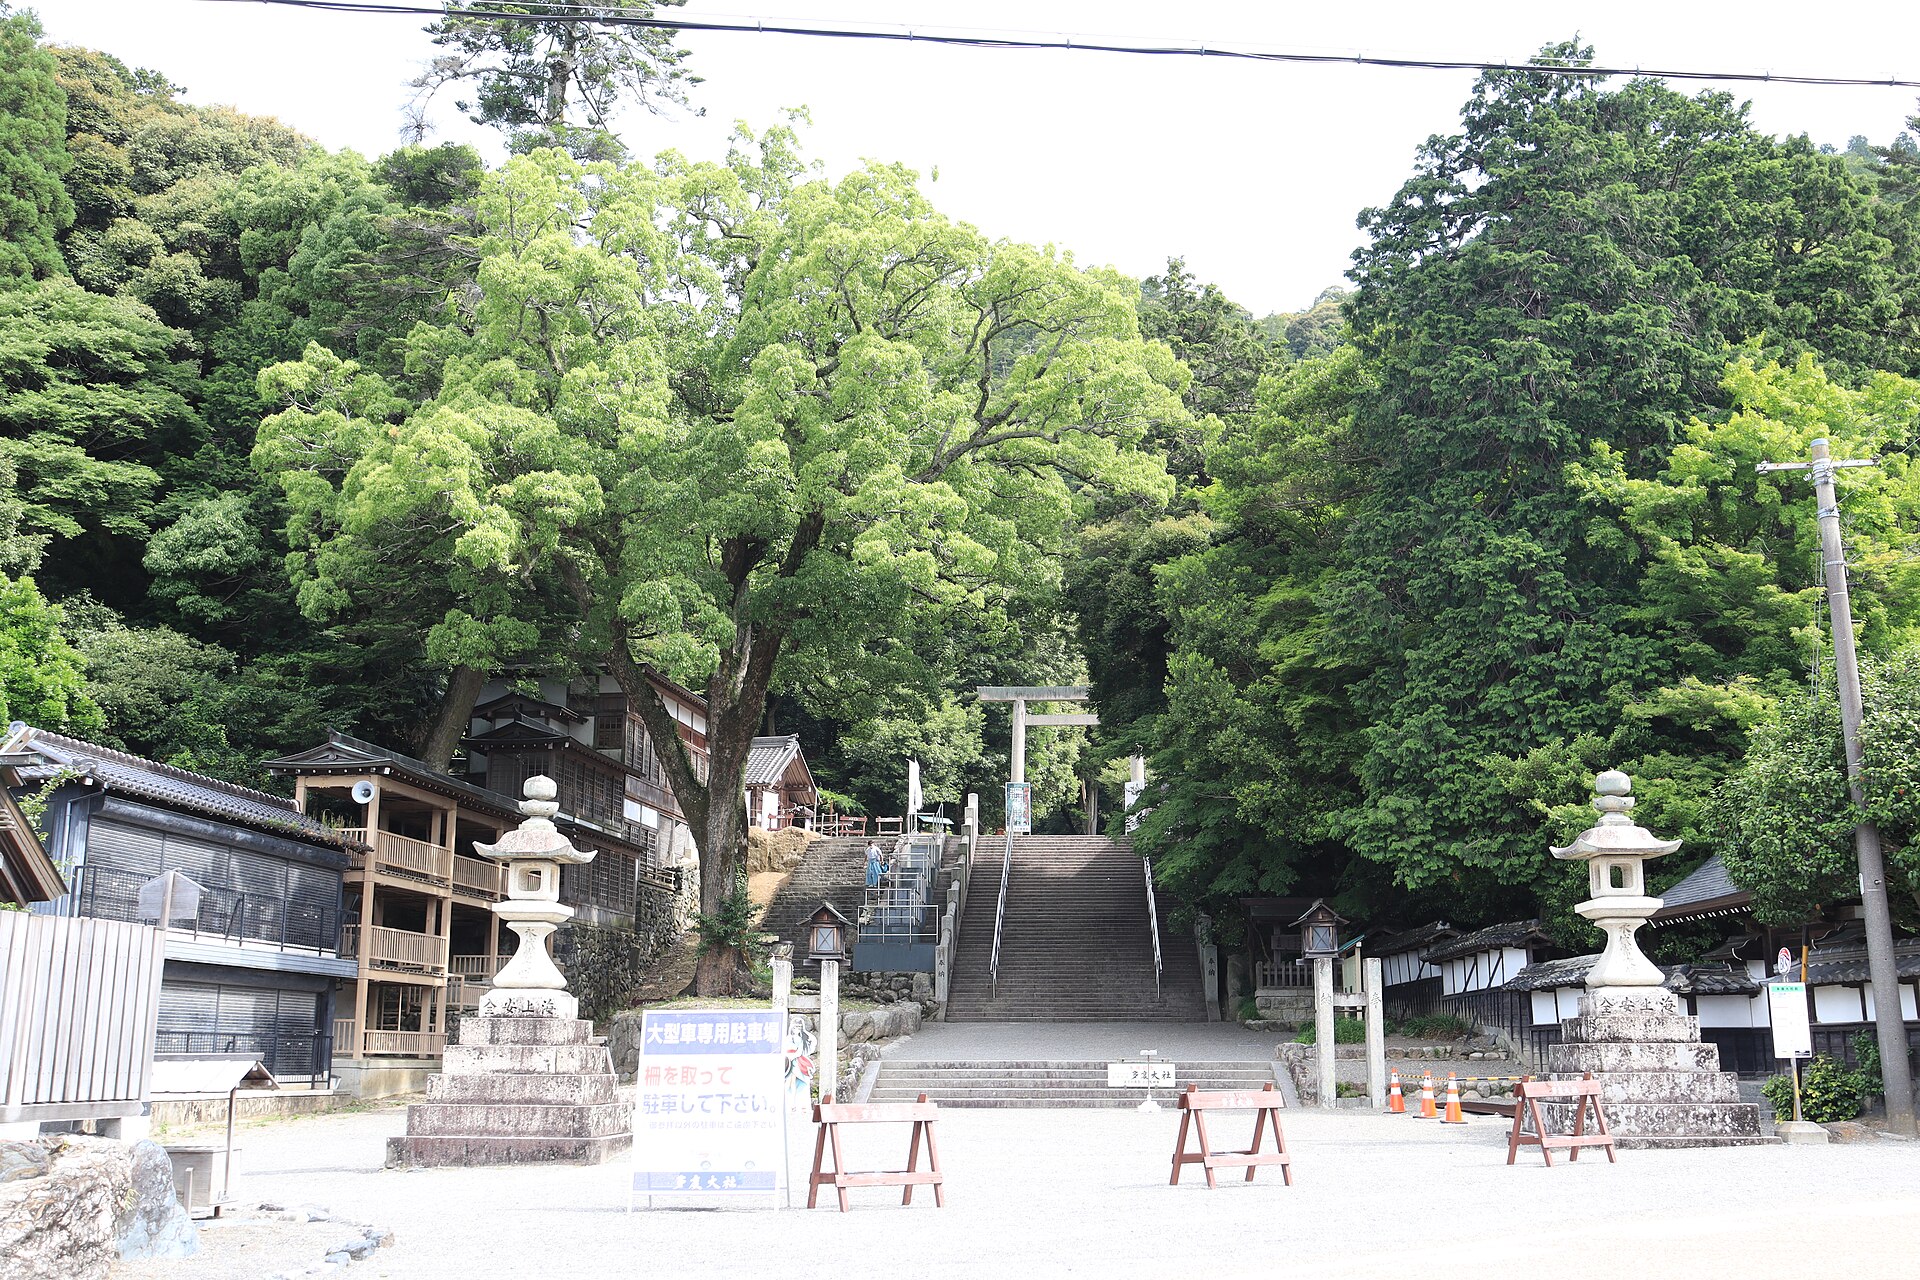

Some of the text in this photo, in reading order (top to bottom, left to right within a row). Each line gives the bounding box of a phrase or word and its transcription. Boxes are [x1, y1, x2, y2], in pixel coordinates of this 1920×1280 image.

[646, 1021, 780, 1045] 大型車専用駐車場
[644, 1065, 733, 1087] 柵を取って
